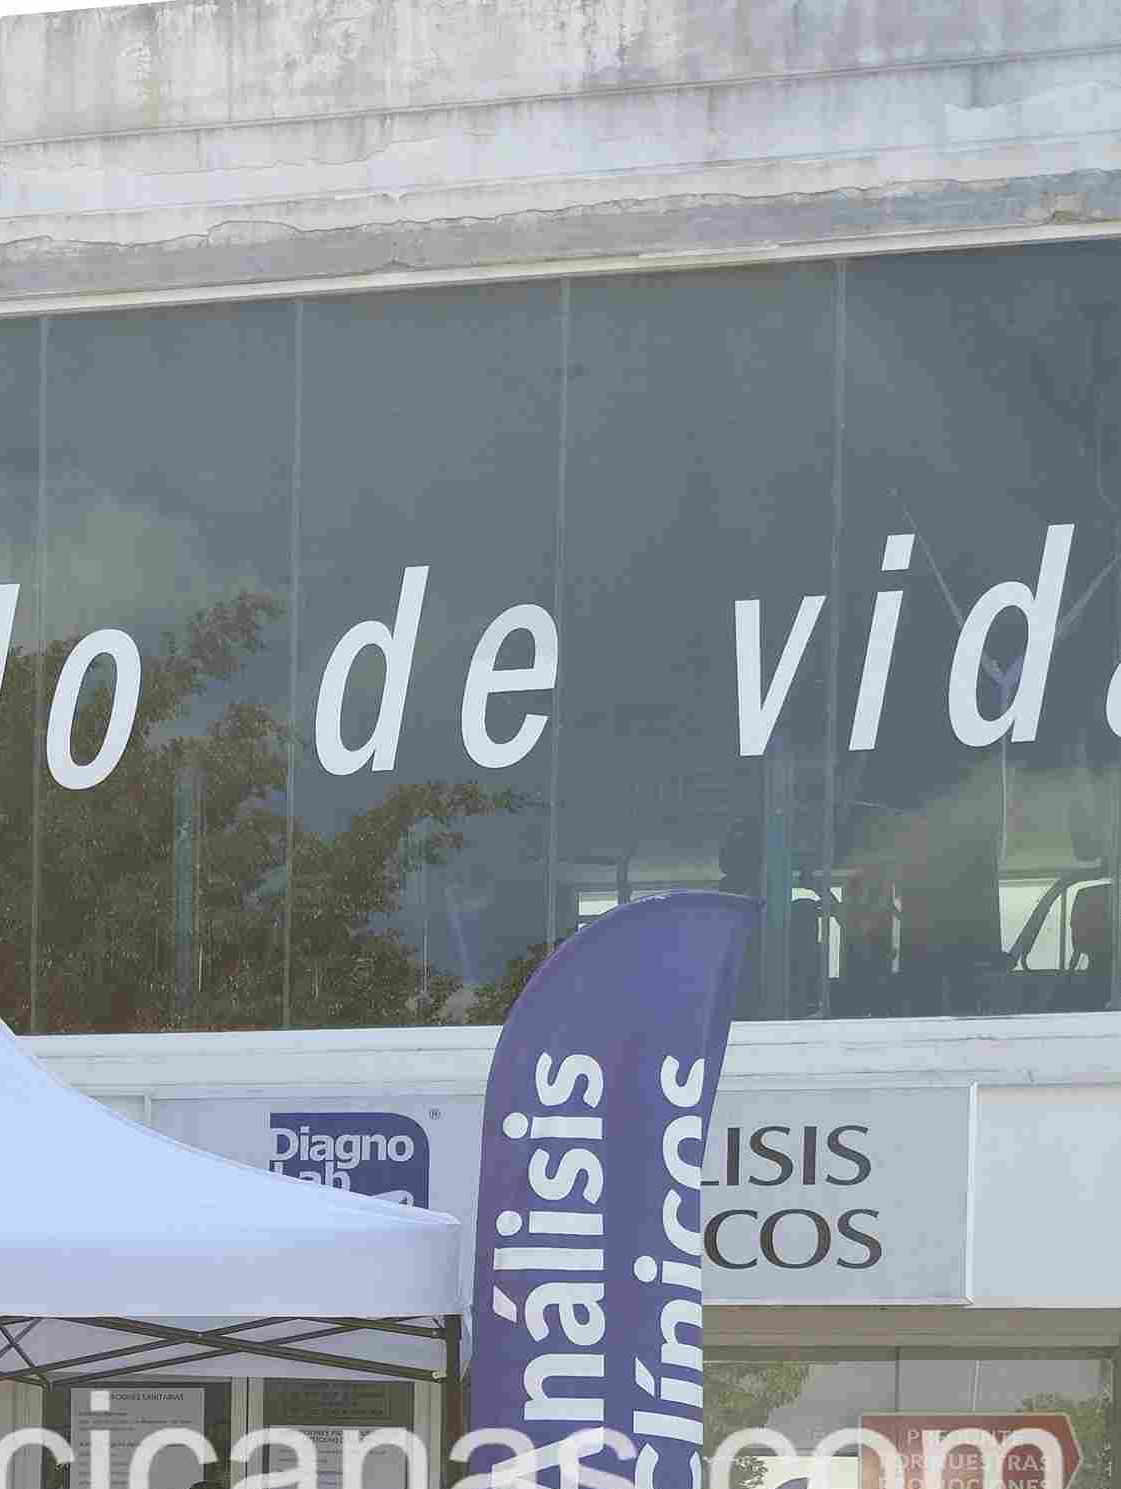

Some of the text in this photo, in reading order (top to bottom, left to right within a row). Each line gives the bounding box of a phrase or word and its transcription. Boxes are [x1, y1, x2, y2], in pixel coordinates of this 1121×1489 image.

[315, 565, 559, 776] de
[734, 523, 1121, 757] vid
[270, 1125, 415, 1169] Diagno
[701, 1125, 872, 1186] ISIS
[703, 1208, 883, 1270] COS
